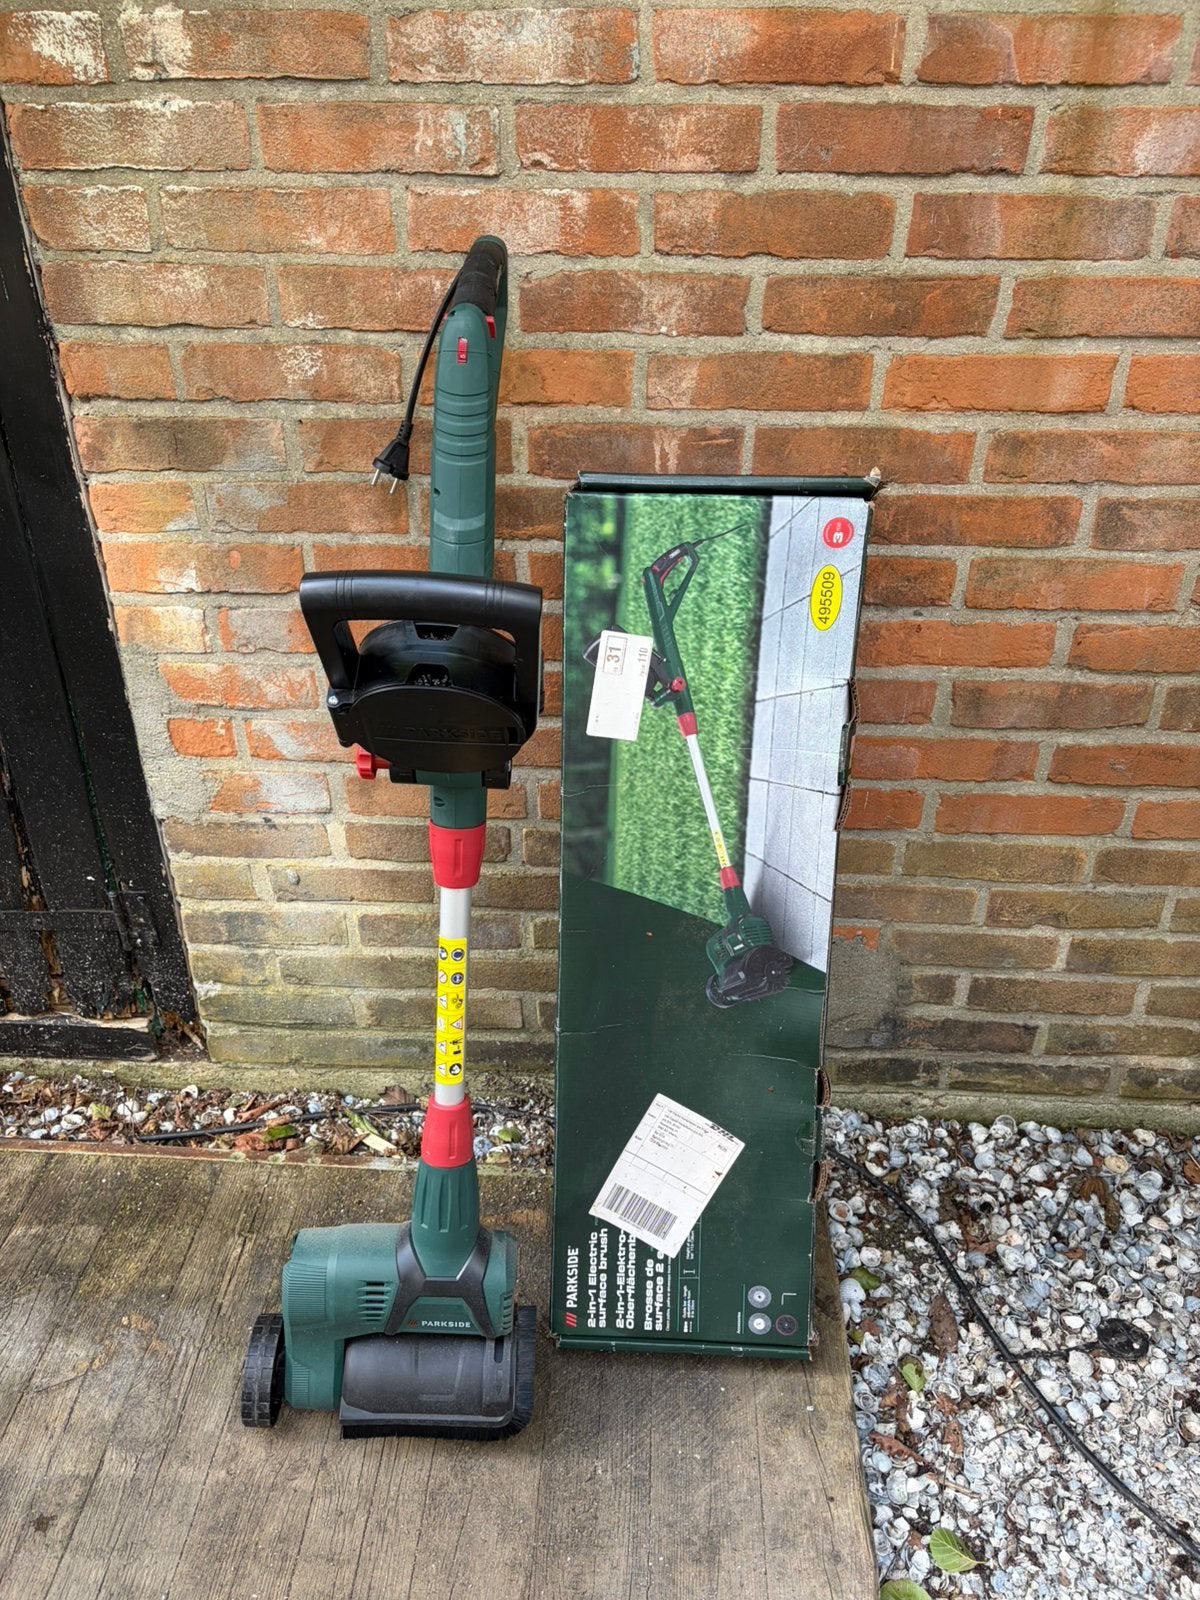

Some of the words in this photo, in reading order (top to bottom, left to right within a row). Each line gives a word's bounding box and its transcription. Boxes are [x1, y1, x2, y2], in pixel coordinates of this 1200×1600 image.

[818, 571, 836, 625] 495509
[606, 646, 622, 664] 31
[637, 647, 649, 662] 110
[588, 1231, 598, 1286] Electric
[598, 1228, 608, 1270] brush
[645, 1258, 655, 1277] de
[655, 1262, 665, 1273] 2
[566, 1247, 579, 1308] PARKSIDE
[587, 1289, 597, 1328] 2-in-1
[598, 1273, 607, 1328] surface
[644, 1280, 654, 1331] Brosse
[654, 1276, 664, 1331] surface
[421, 1320, 471, 1328] PARKSIDE
